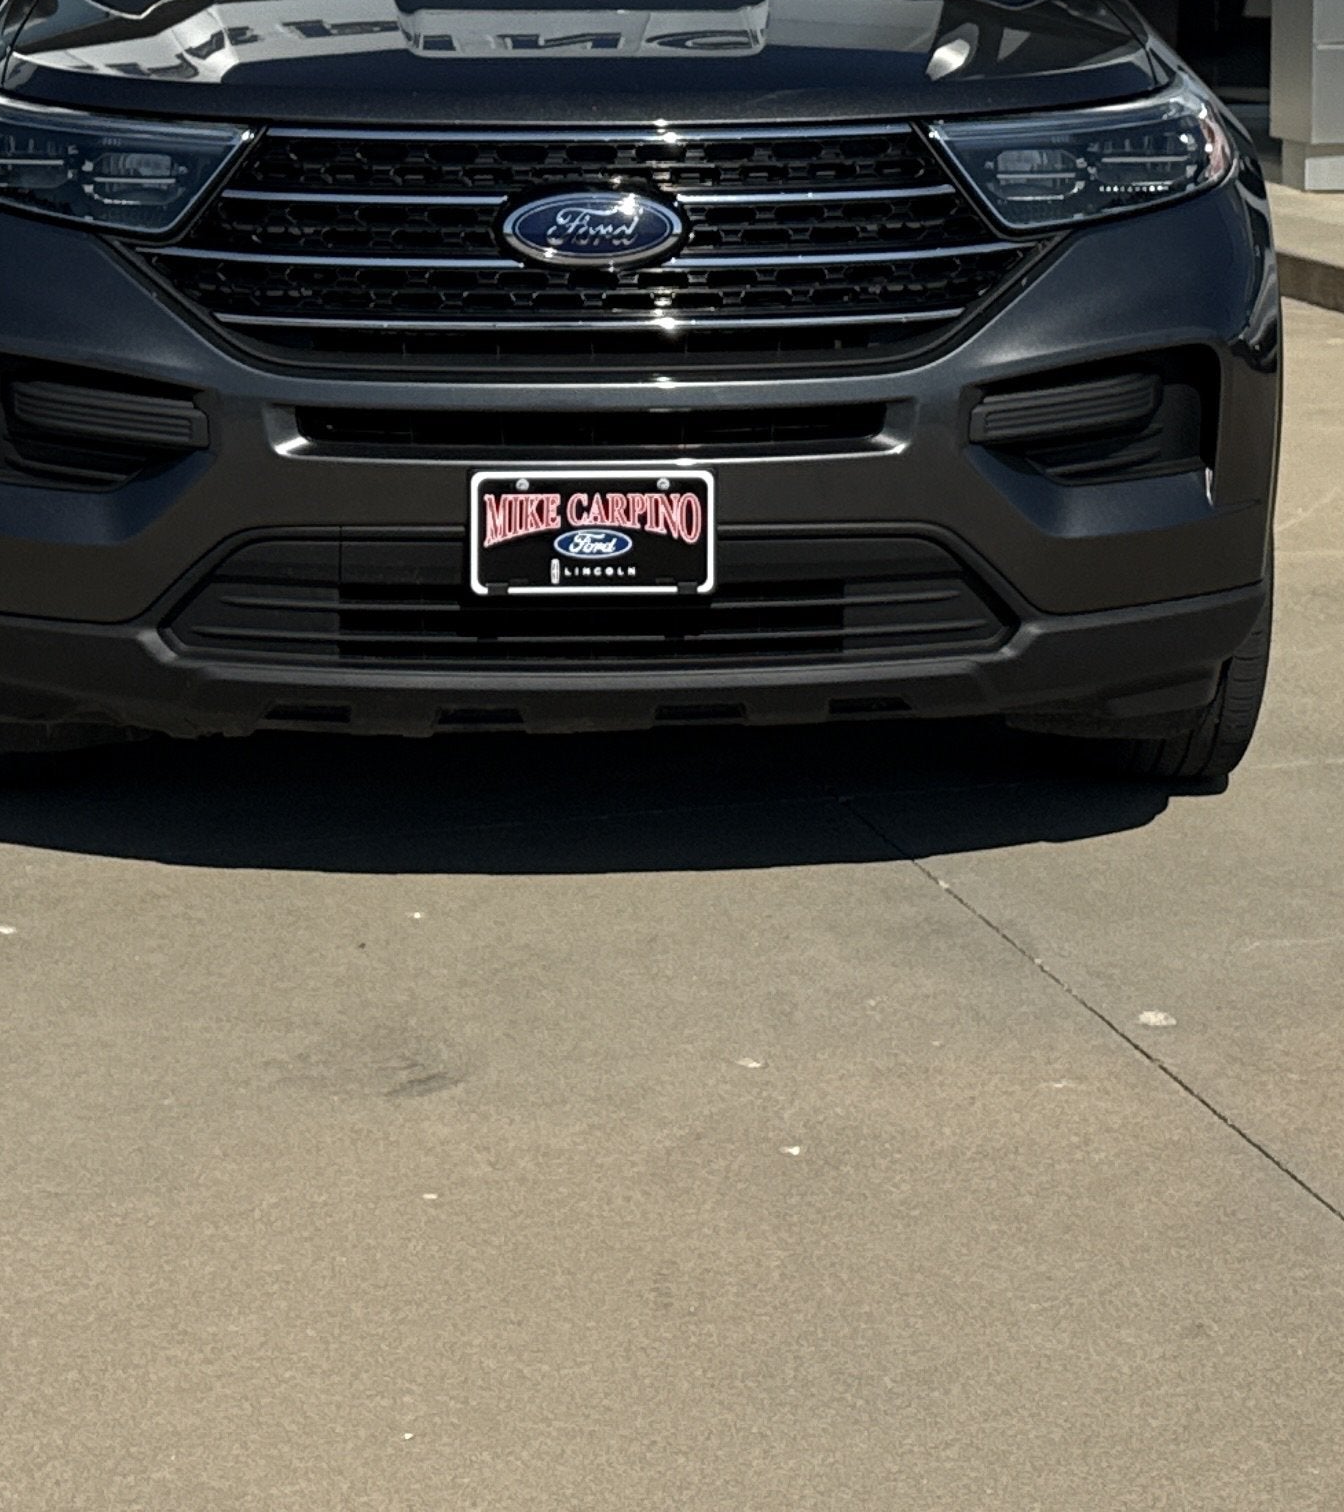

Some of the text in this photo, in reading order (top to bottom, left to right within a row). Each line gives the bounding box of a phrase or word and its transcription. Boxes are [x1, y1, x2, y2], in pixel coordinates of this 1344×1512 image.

[546, 207, 640, 246] Ford
[483, 492, 702, 548] MIKE CARPINO
[568, 532, 618, 554] Ford
[563, 566, 637, 577] LINCOLN
